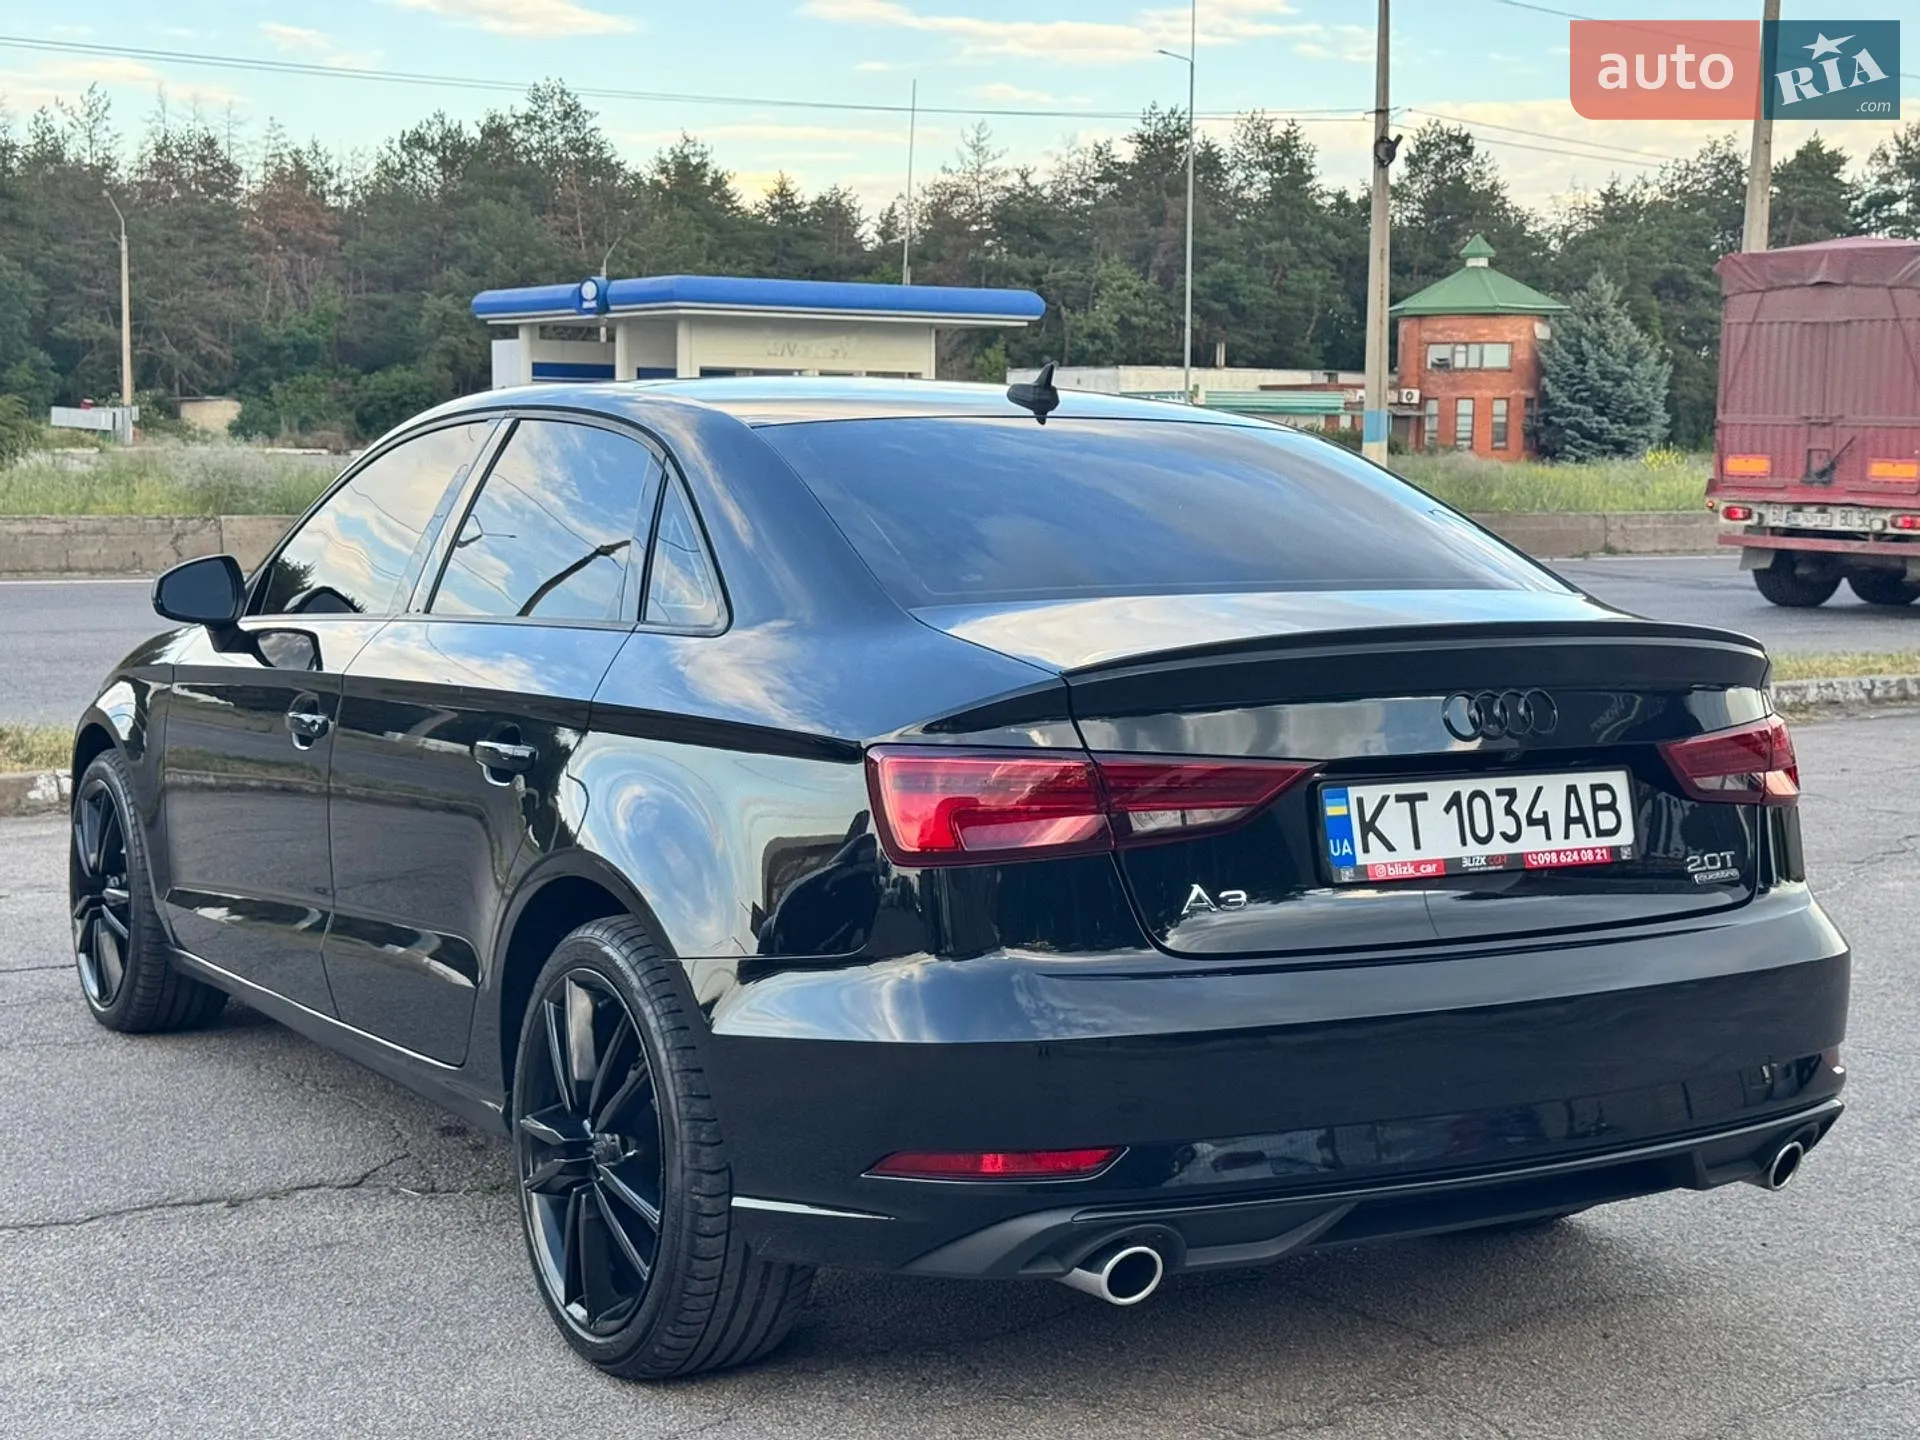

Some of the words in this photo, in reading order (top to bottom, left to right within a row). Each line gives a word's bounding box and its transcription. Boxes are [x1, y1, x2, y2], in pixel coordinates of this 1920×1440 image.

[1355, 792, 1429, 854] KT
[1443, 785, 1553, 847] 1034
[1562, 782, 1623, 841] AB
[1330, 838, 1354, 857] UA
[1537, 852, 1558, 866] 098
[1559, 850, 1579, 864] 624
[1594, 848, 1608, 860] 21
[1387, 862, 1438, 876] blizk_car
[1181, 883, 1248, 915] A3
